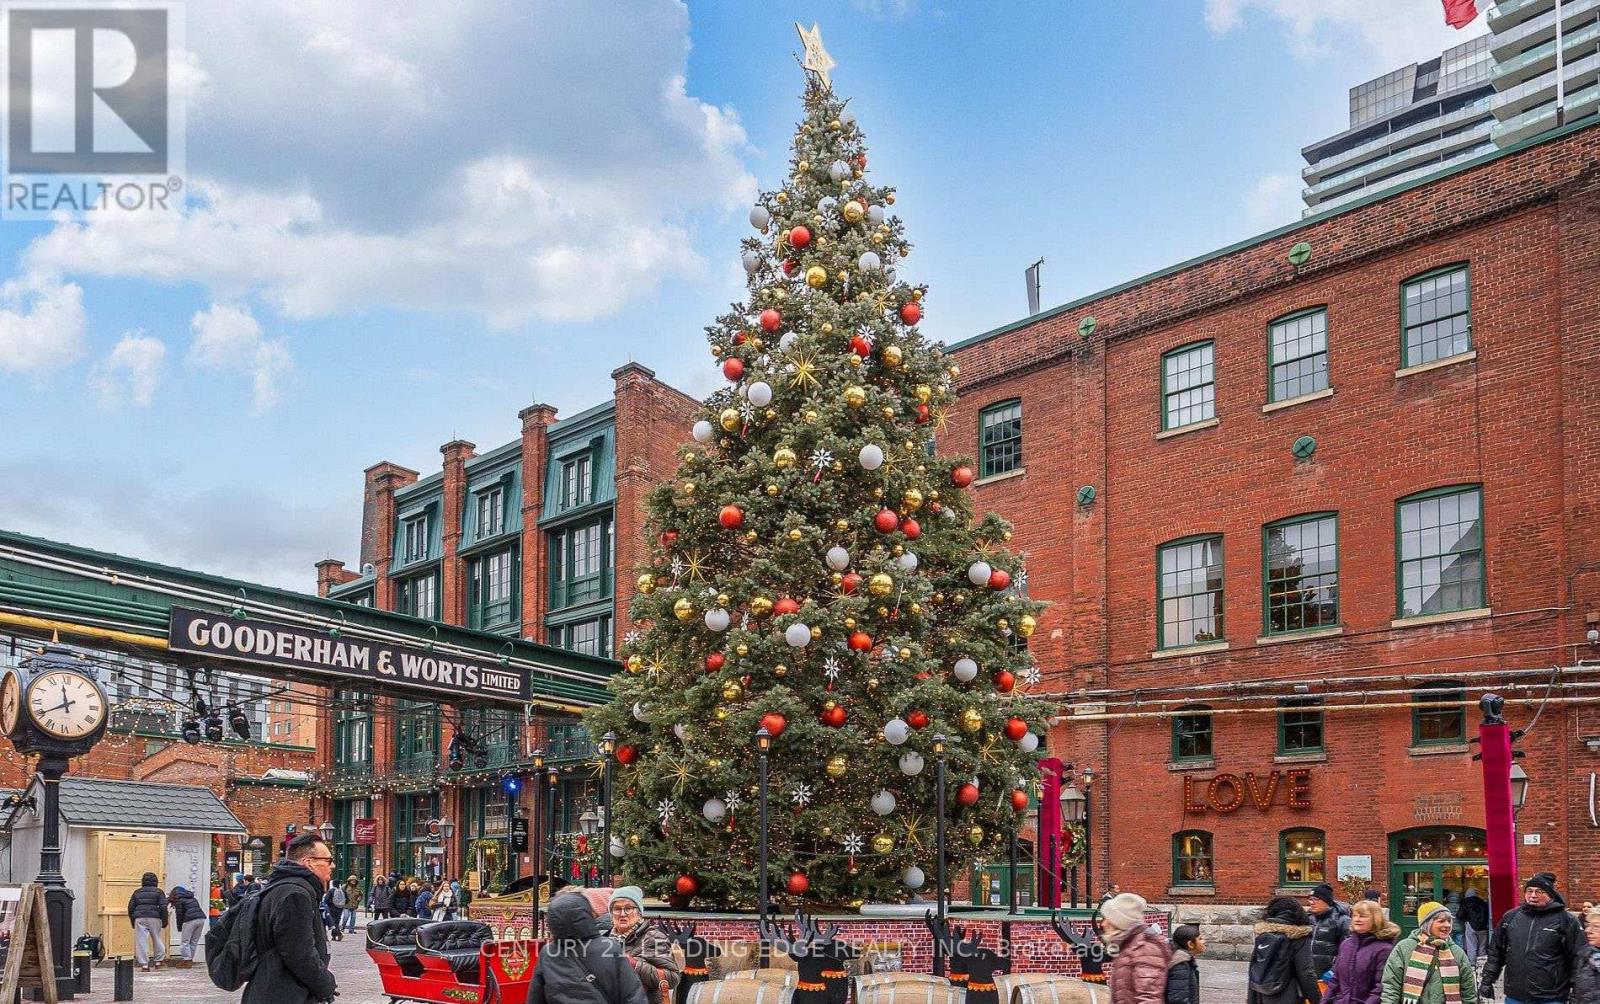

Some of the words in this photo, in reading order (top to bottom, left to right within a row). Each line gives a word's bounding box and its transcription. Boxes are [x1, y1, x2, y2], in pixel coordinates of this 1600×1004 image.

[187, 619, 369, 670] GOODERHAM
[376, 651, 397, 675] &
[400, 653, 479, 688] WORTS
[481, 672, 521, 690] LIMITED
[1184, 769, 1311, 813] LOVE
